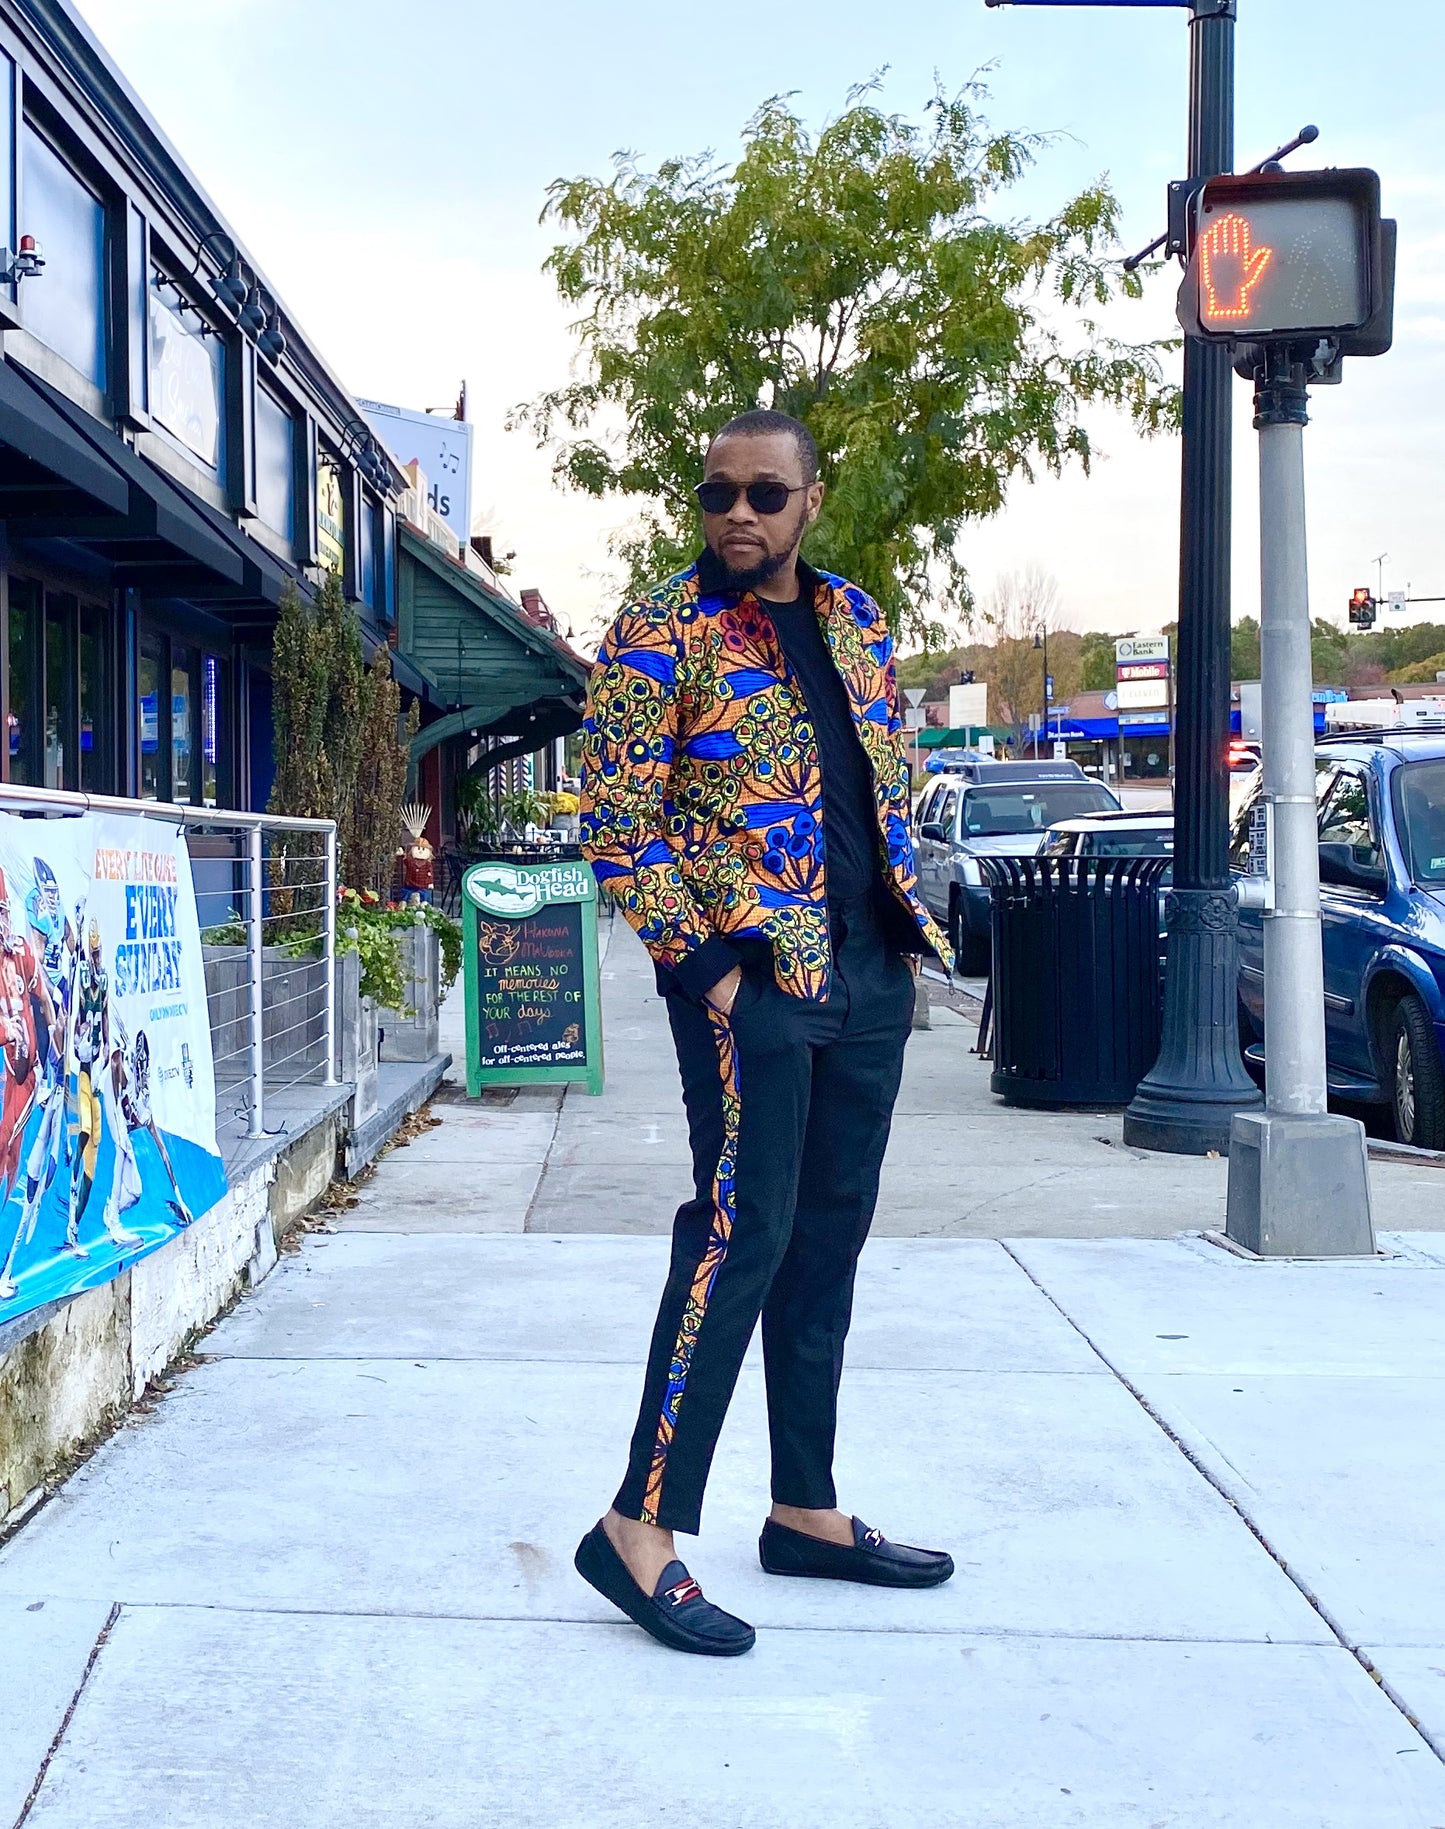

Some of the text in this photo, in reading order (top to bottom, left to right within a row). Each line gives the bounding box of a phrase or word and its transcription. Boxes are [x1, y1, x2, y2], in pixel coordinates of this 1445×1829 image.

[1132, 642, 1163, 650] Eastern
[1132, 648, 1154, 656] Bank
[1131, 666, 1160, 677] Mobile
[96, 849, 131, 880] EVERY
[517, 867, 583, 886] Dogfish
[536, 878, 589, 901] Head
[126, 885, 177, 940] EVERY
[115, 941, 182, 997] SUNDAY
[484, 964, 568, 977] IT MEANS NO
[498, 978, 560, 991] memories
[485, 989, 581, 1004] FOR THE REST OF
[483, 1004, 552, 1025] YOUR days
[493, 1041, 571, 1054] Off-centered ales
[482, 1050, 586, 1065] for off-centered people.
